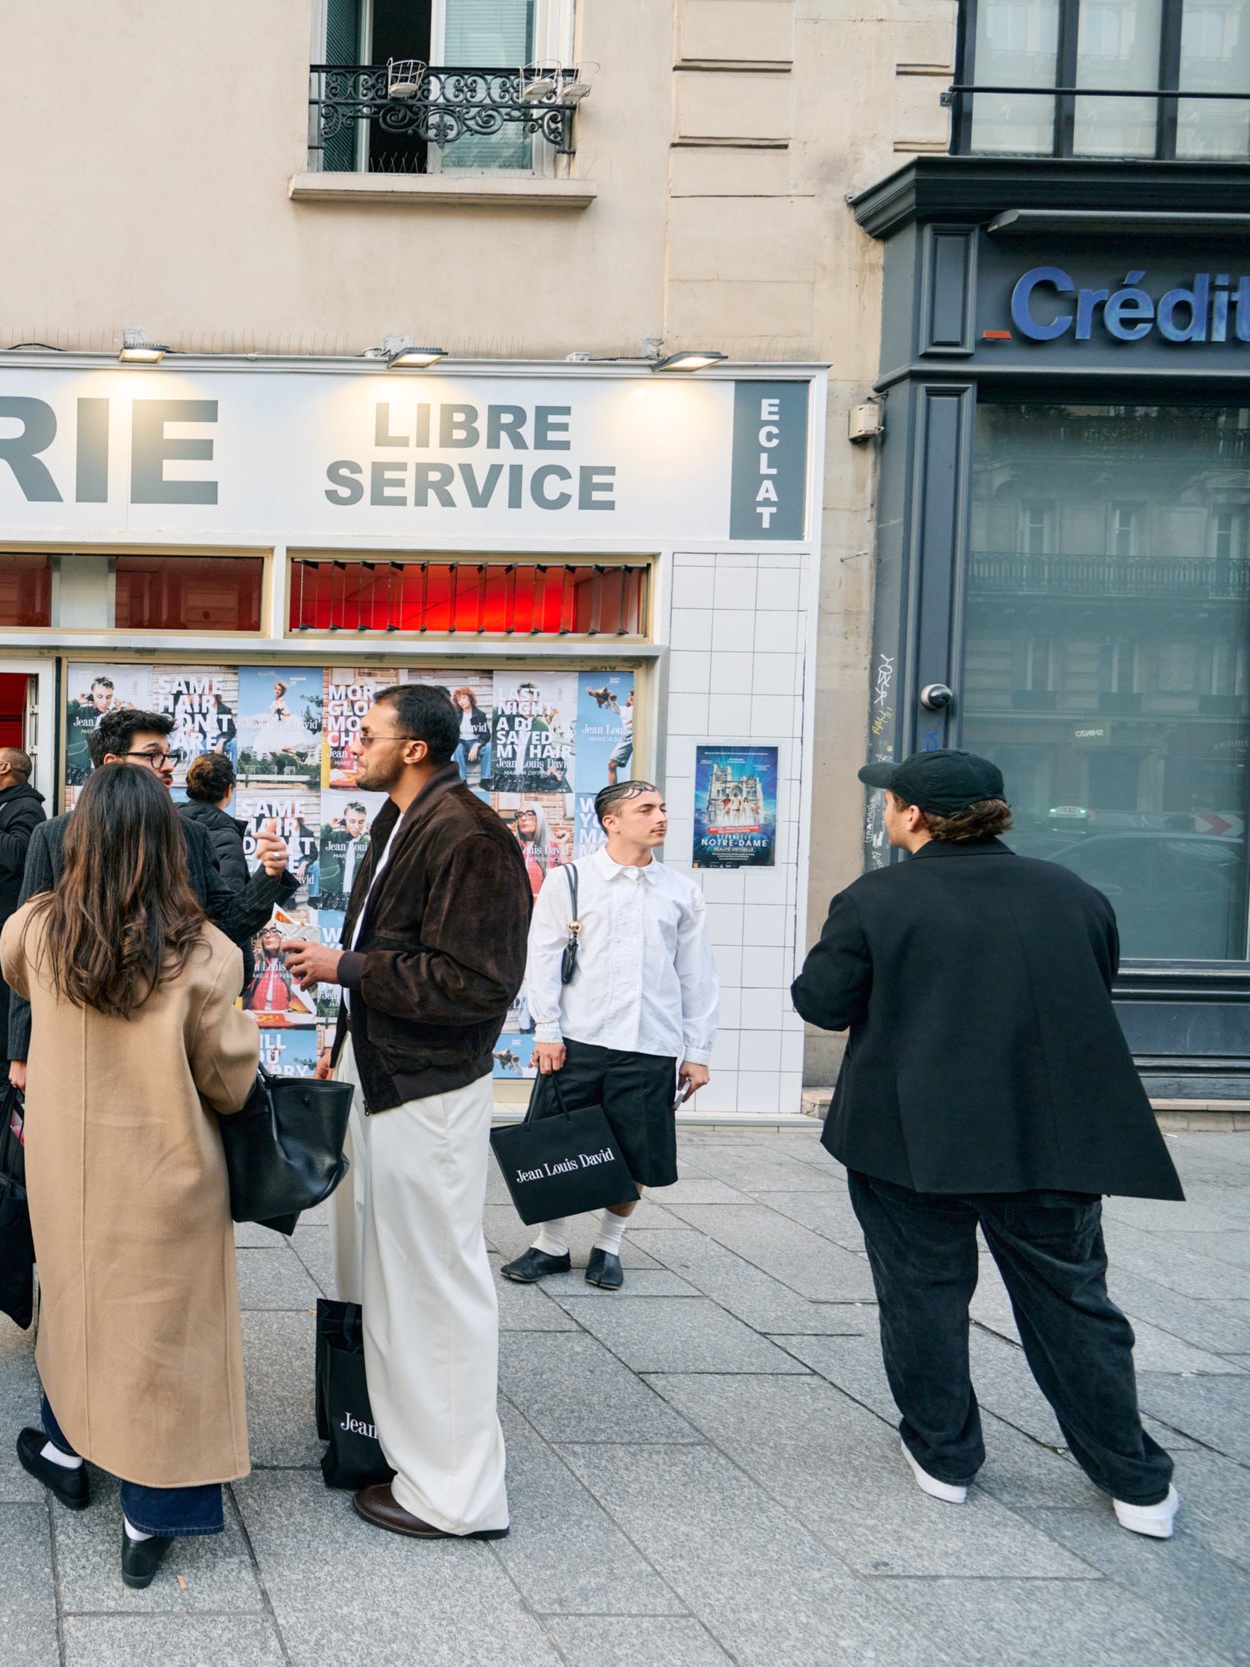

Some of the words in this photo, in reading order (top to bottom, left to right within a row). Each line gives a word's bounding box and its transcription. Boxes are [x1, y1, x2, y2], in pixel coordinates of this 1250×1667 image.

[1011, 265, 1250, 343] Crédit
[375, 402, 572, 451] LIBRE
[755, 398, 780, 528] ECLAT
[324, 459, 616, 511] SERVICE
[158, 676, 224, 695] SAME
[498, 688, 540, 702] LAST
[158, 694, 218, 713] HAIR
[497, 702, 555, 715] NIGHT
[73, 717, 95, 727] Jean
[496, 717, 510, 731] A
[515, 717, 533, 731] DJ
[581, 723, 603, 734] Jean
[496, 730, 552, 745] SAVED
[496, 744, 522, 758] MY
[529, 744, 572, 759] HAIR
[496, 758, 517, 769] Jean
[240, 800, 306, 818] SAME
[325, 841, 346, 852] Jean
[701, 838, 767, 848] NOTRE-DAME
[516, 1168, 545, 1183] Jean
[543, 1158, 578, 1176] Louis
[578, 1147, 615, 1168] David
[340, 1411, 378, 1440] Jean
